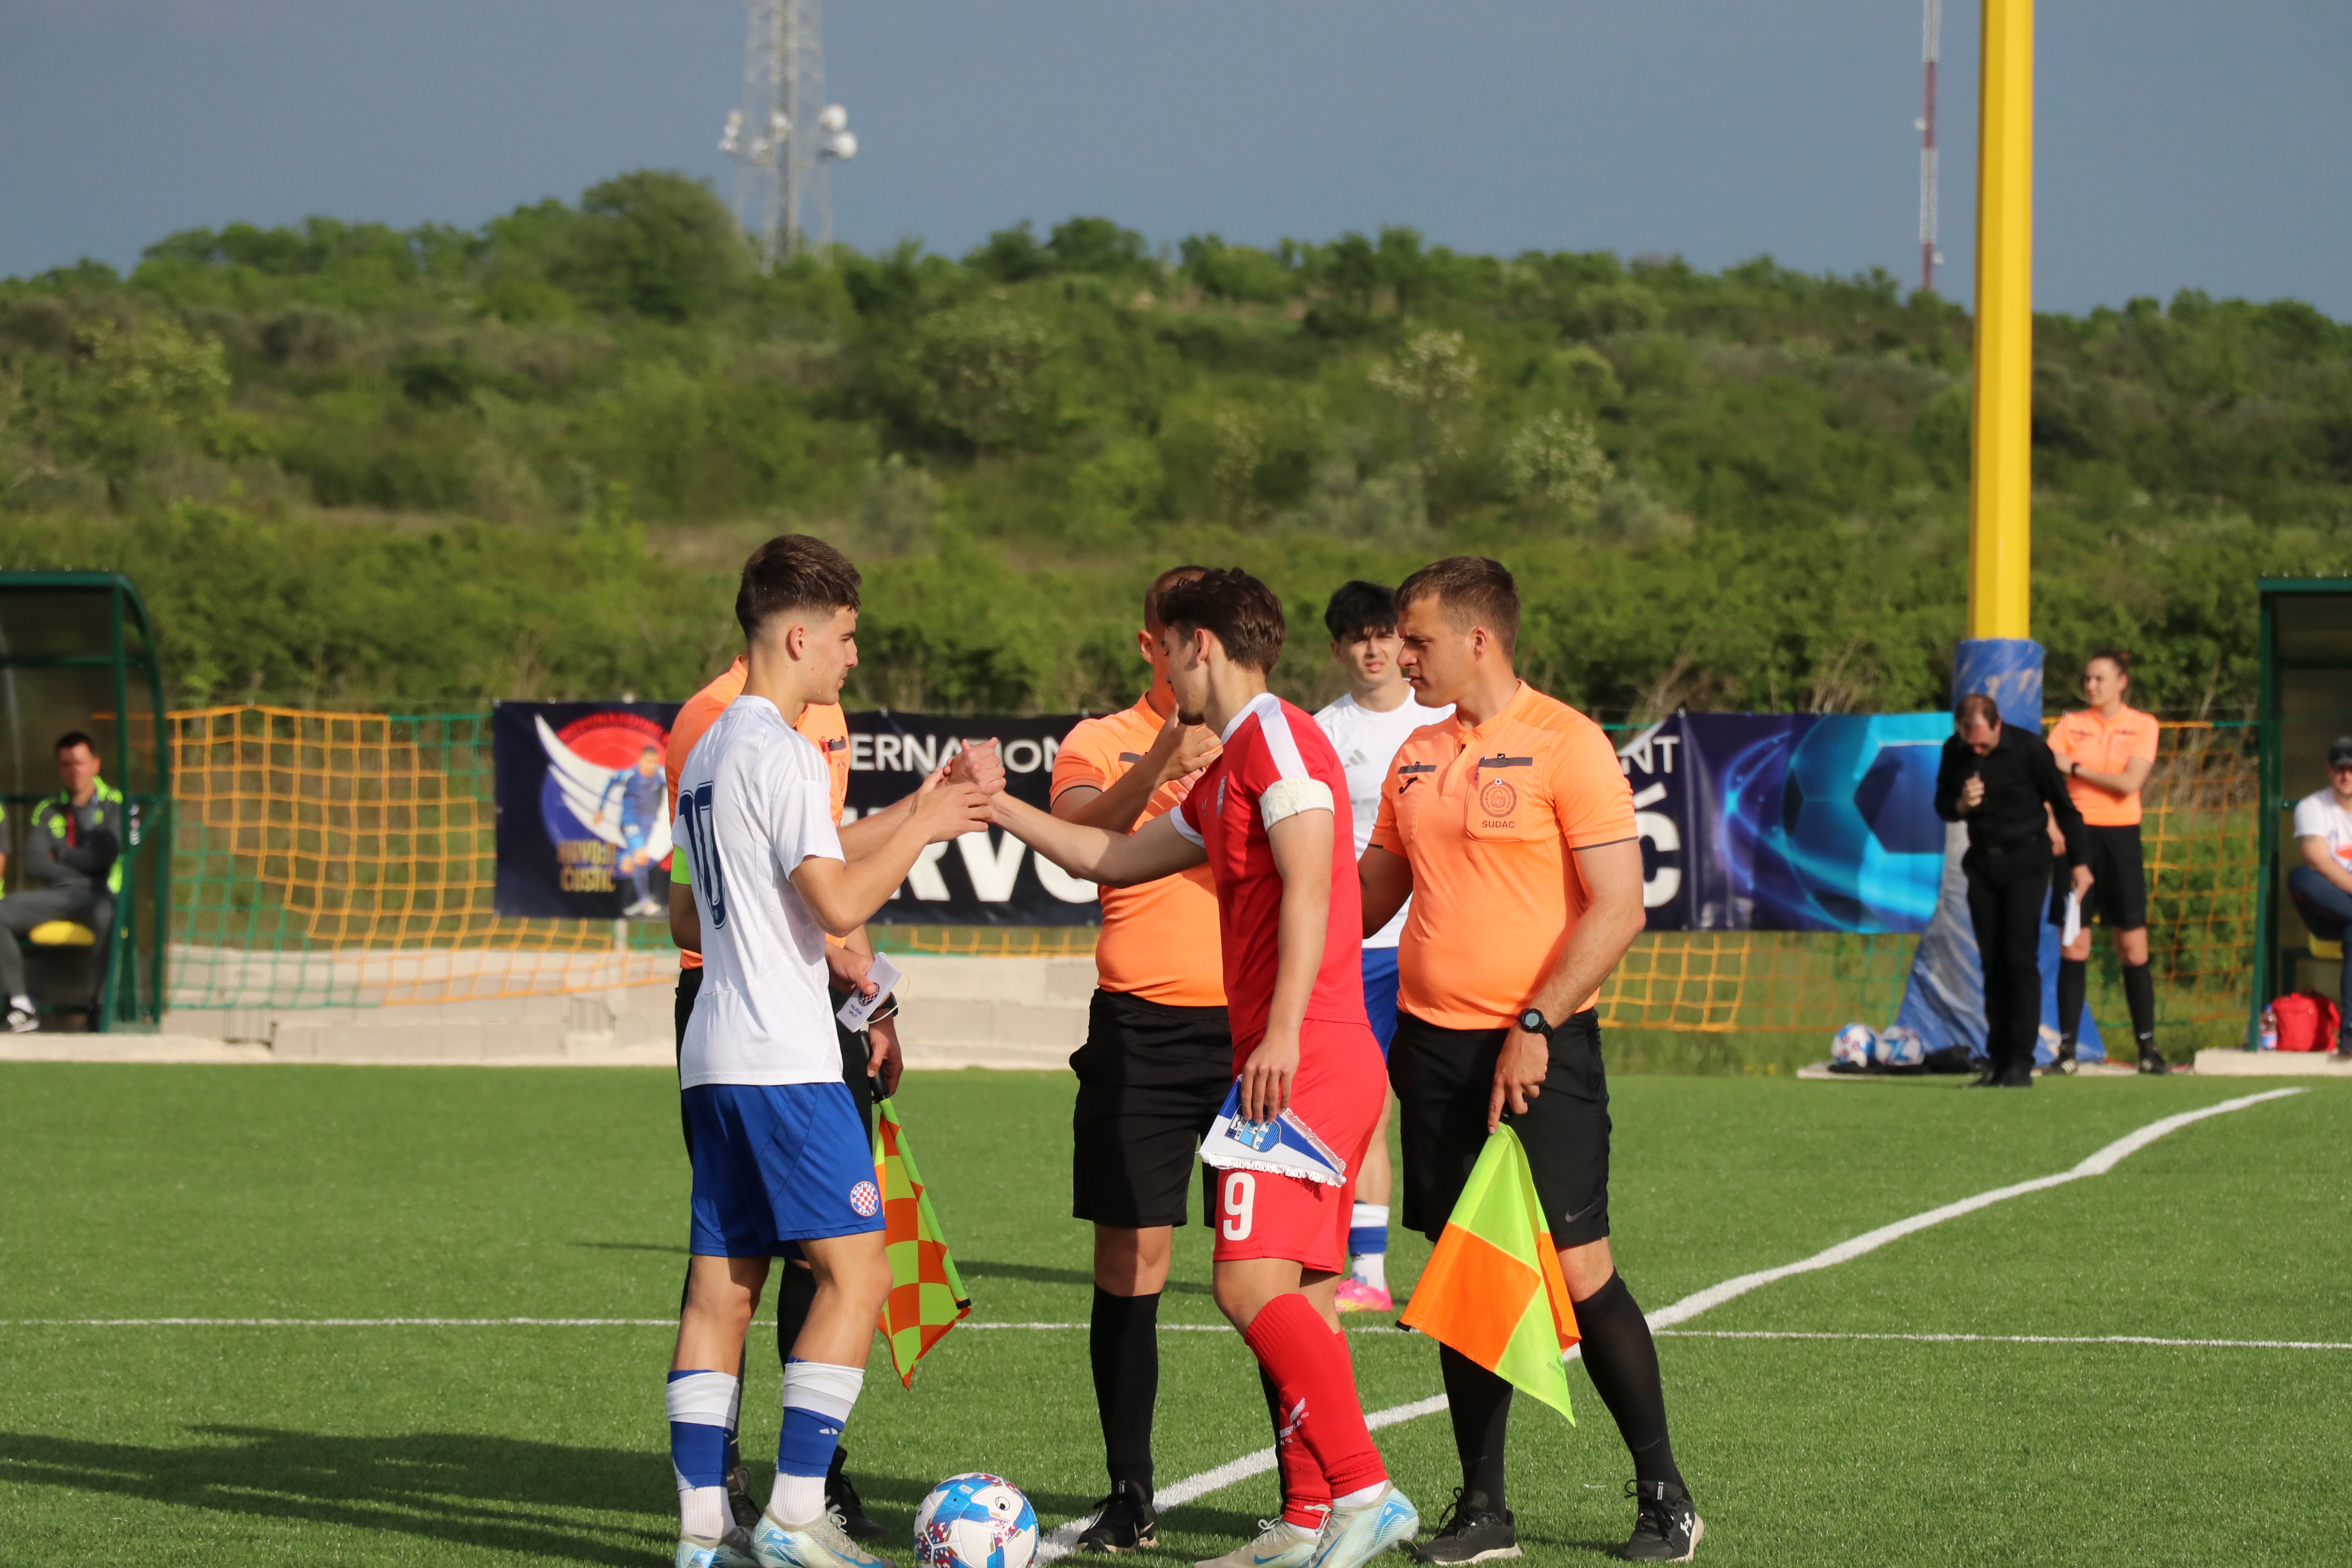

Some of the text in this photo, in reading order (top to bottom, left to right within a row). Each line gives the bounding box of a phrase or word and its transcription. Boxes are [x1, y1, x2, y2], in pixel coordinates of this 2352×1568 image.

[1482, 820, 1515, 829] SUDAC
[679, 780, 726, 929] 10
[852, 1183, 875, 1194] HAJDUK
[858, 1206, 876, 1214] SPLIT
[1223, 1172, 1256, 1241] 9
